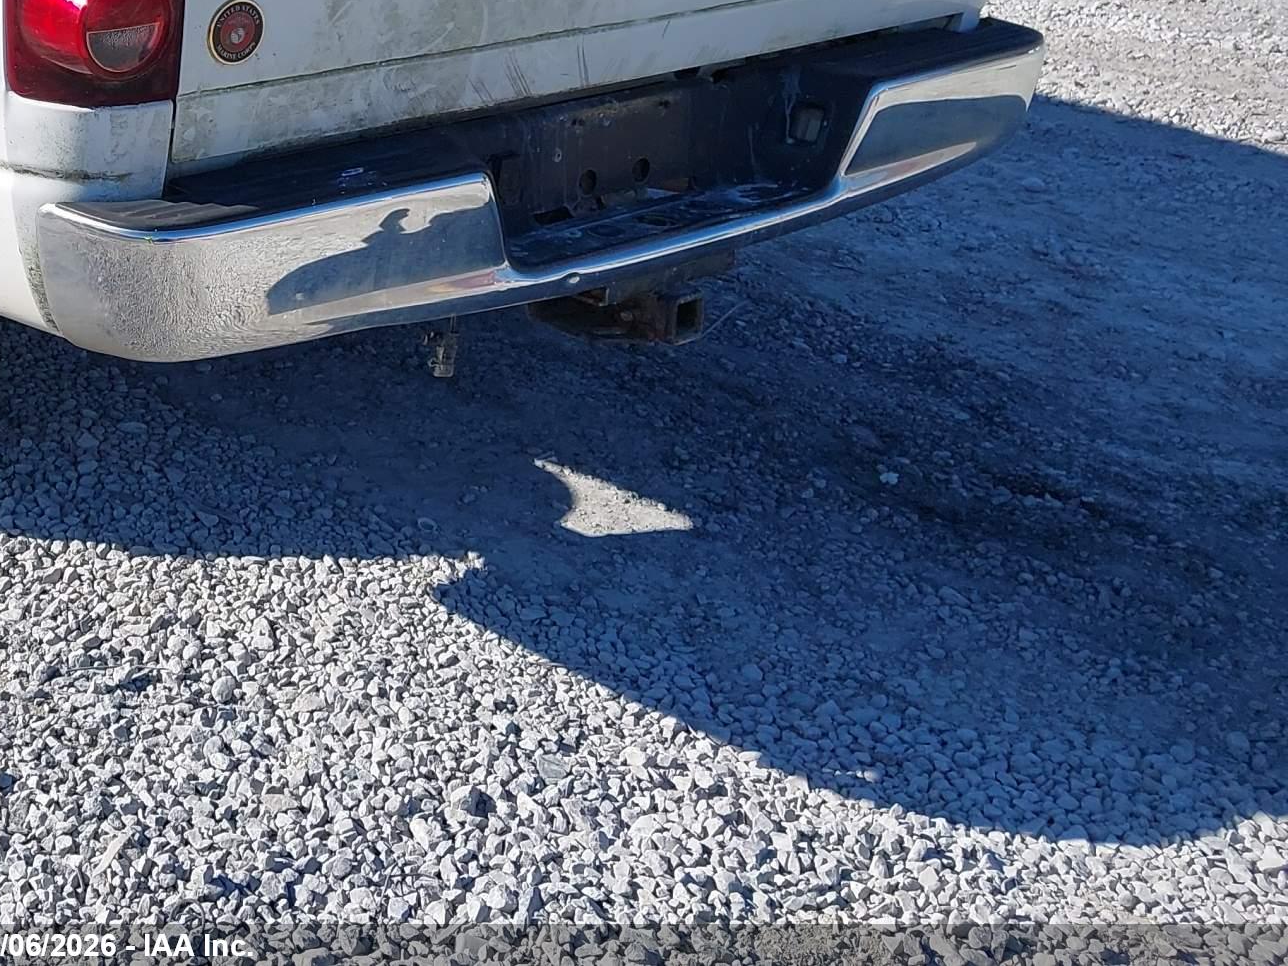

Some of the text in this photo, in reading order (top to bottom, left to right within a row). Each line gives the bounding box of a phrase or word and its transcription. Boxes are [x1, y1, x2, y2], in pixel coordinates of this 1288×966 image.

[216, 4, 260, 27] UNITED STATES
[216, 42, 236, 59] MARINE
